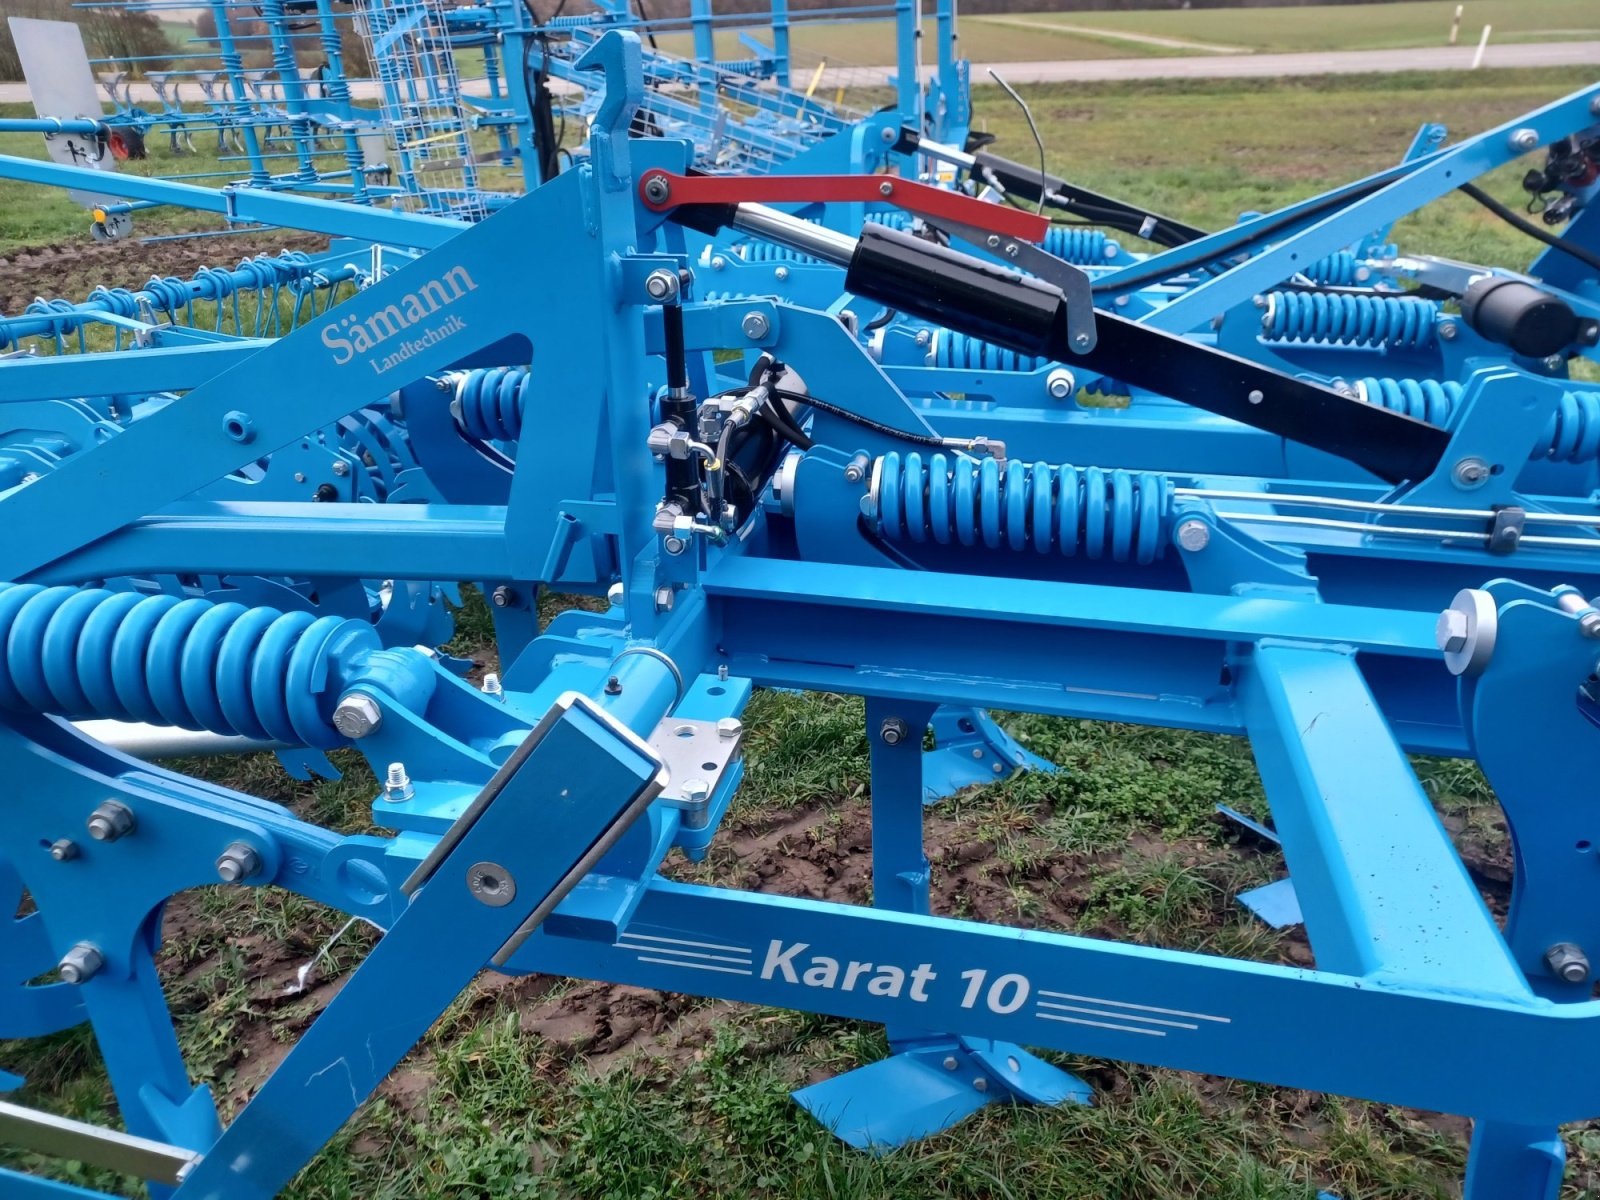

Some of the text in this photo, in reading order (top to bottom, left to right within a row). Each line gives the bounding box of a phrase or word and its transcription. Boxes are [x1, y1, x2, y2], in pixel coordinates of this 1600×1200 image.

[321, 265, 479, 365] Sämann
[369, 314, 467, 375] Landtechnik
[760, 939, 1030, 1014] Karat 10
